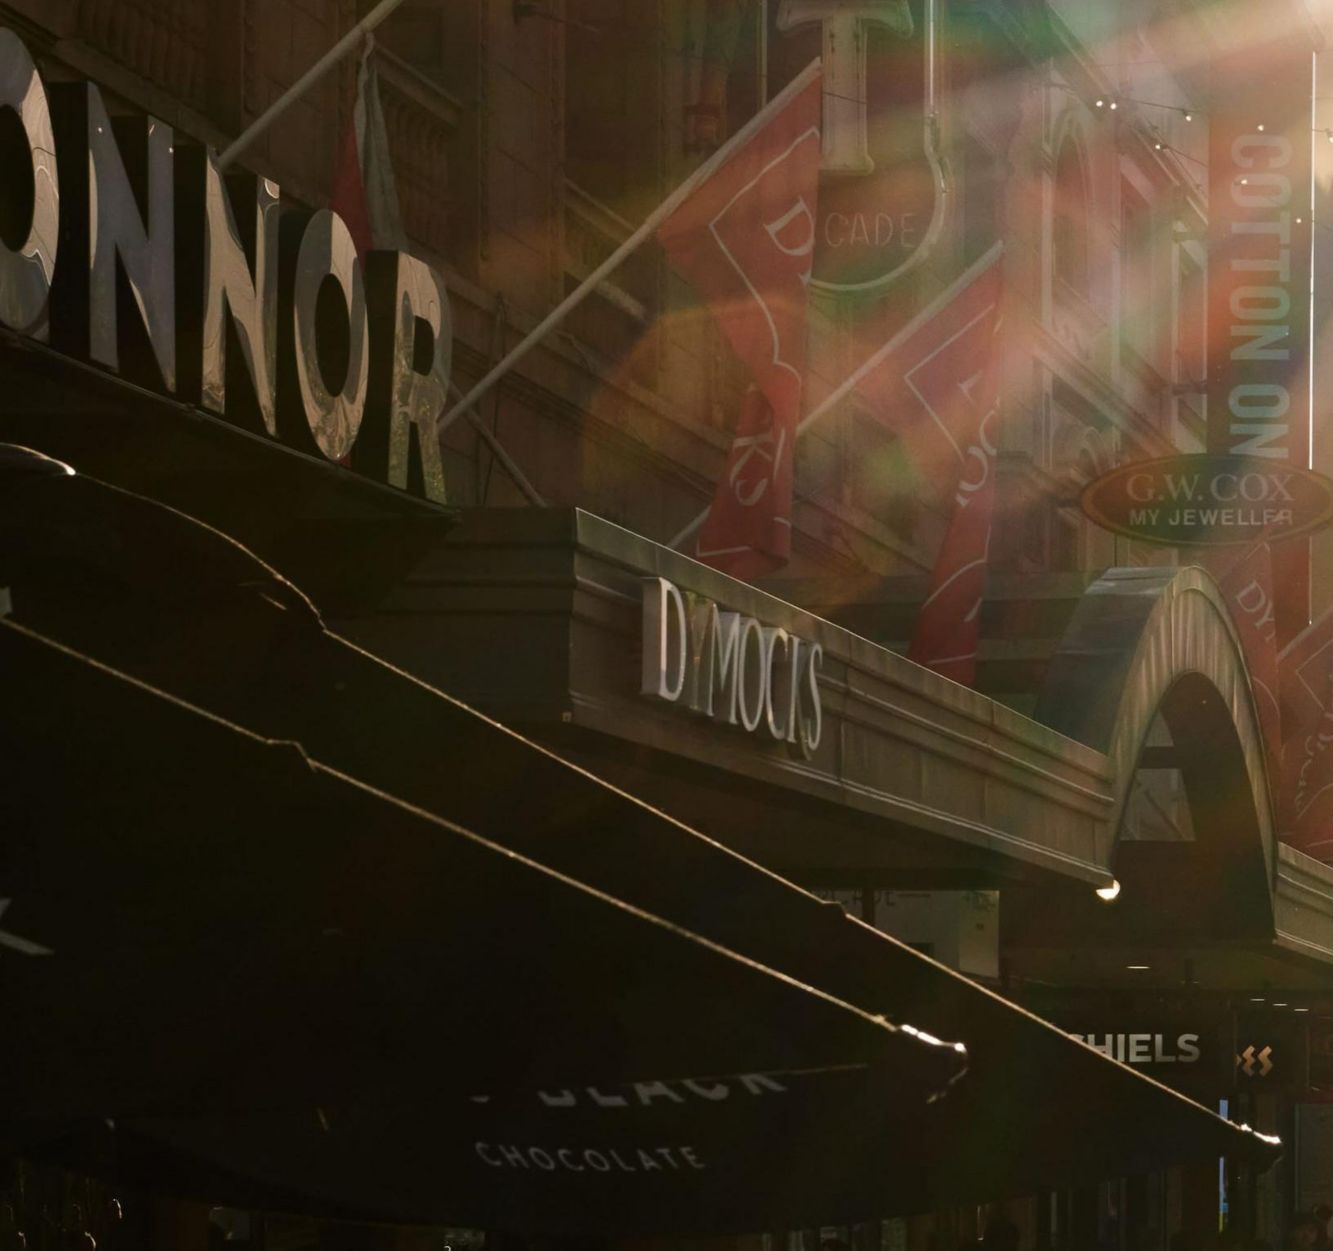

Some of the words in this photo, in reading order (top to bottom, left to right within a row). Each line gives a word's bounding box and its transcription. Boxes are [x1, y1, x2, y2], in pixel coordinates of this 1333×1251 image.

[1229, 133, 1293, 361] COTTON
[1227, 383, 1291, 459] ON
[1210, 472, 1296, 502] COX
[1128, 508, 1164, 527] MY
[474, 1141, 706, 1172] CHOCOLATE
